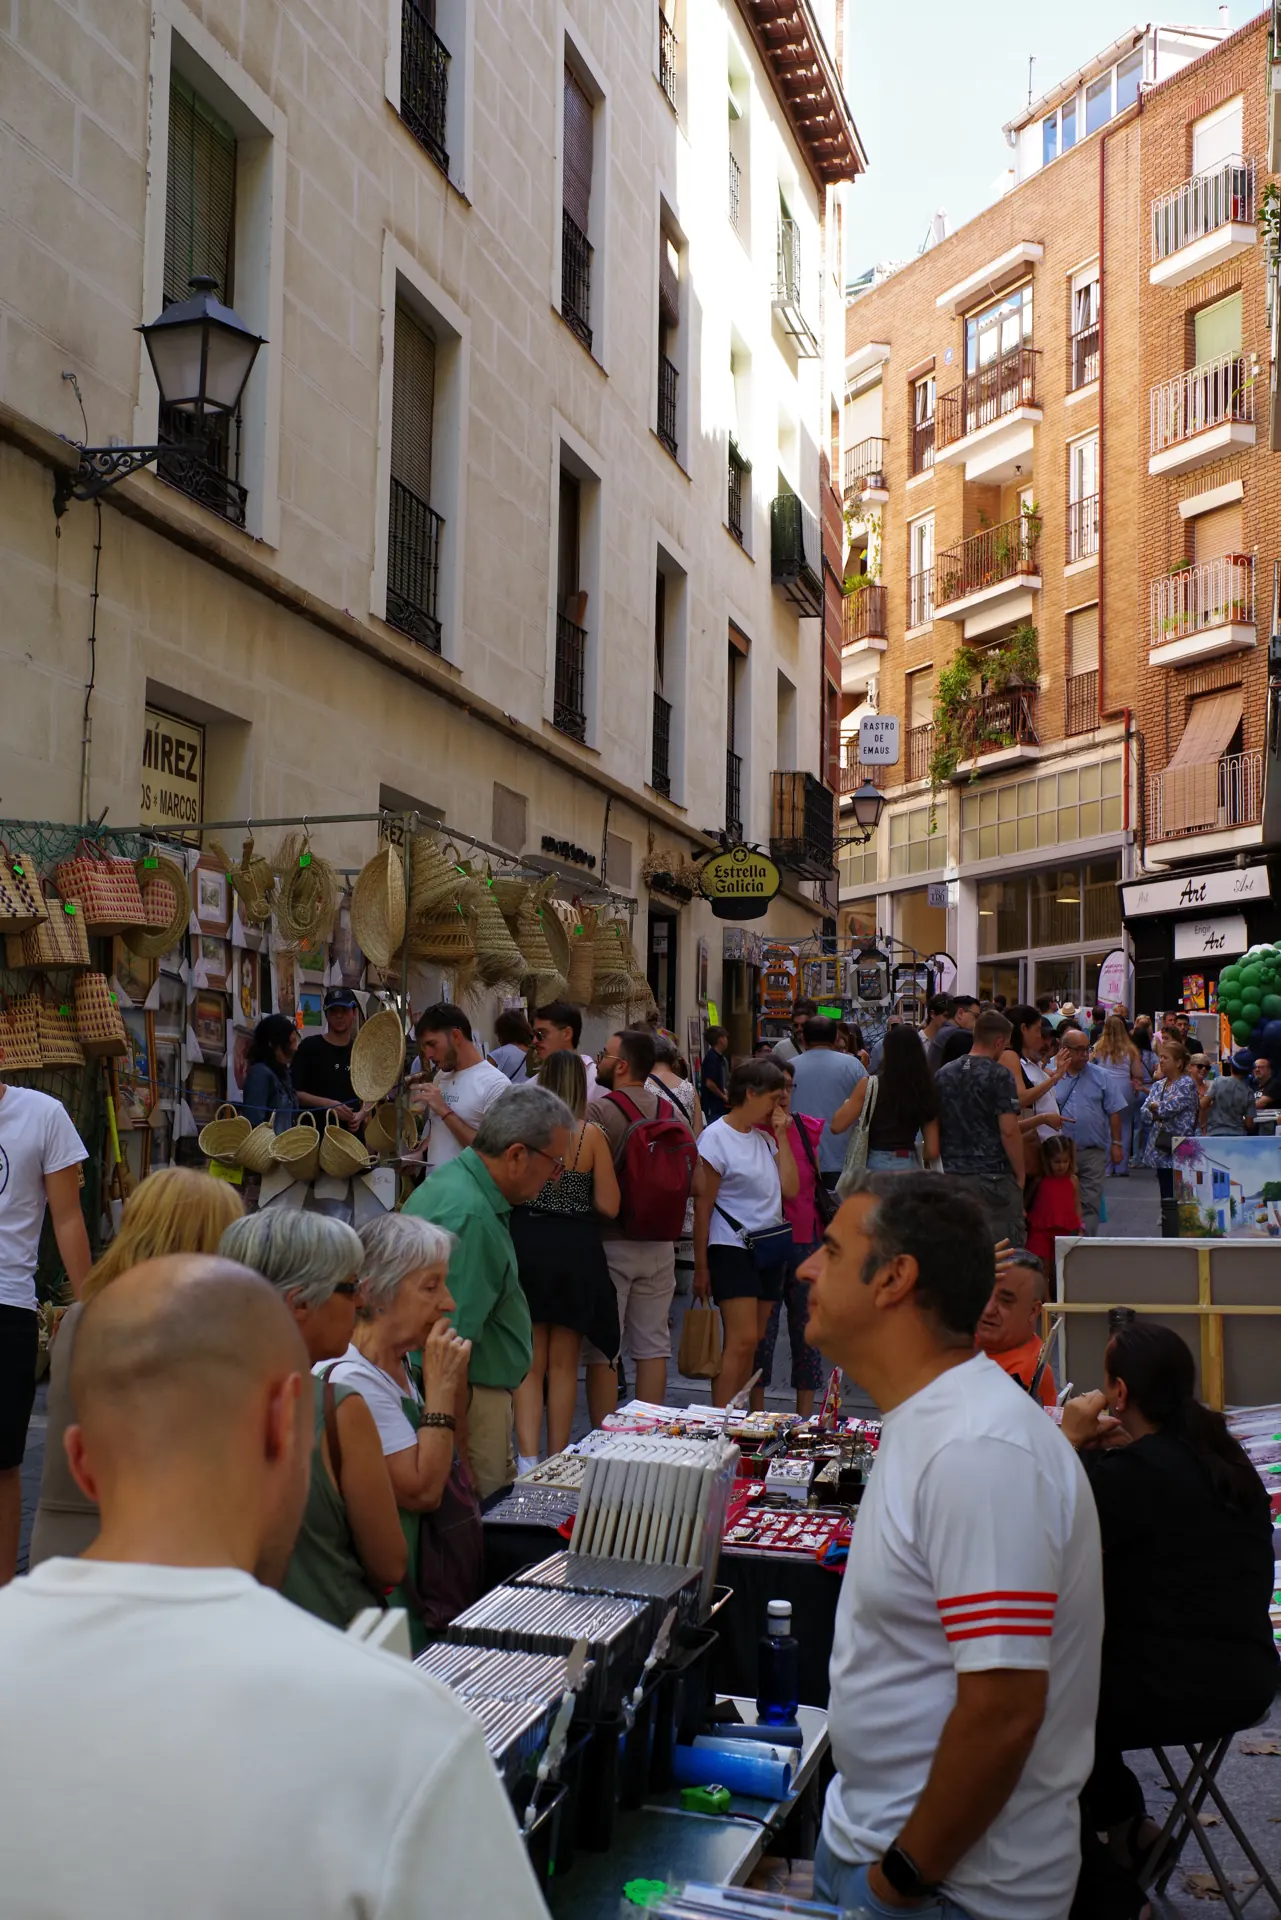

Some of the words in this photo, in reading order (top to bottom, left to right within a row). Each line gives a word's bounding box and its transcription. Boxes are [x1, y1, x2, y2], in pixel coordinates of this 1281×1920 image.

[863, 722, 895, 731] RASTRO
[874, 734, 884, 743] DE
[863, 746, 890, 755] EMAUS
[160, 789, 197, 823] MARCOS
[714, 865, 766, 878] Estrella
[715, 879, 764, 893] Galicia
[1179, 879, 1207, 905] Art
[1233, 874, 1254, 893] Art
[1203, 931, 1225, 951] Art
